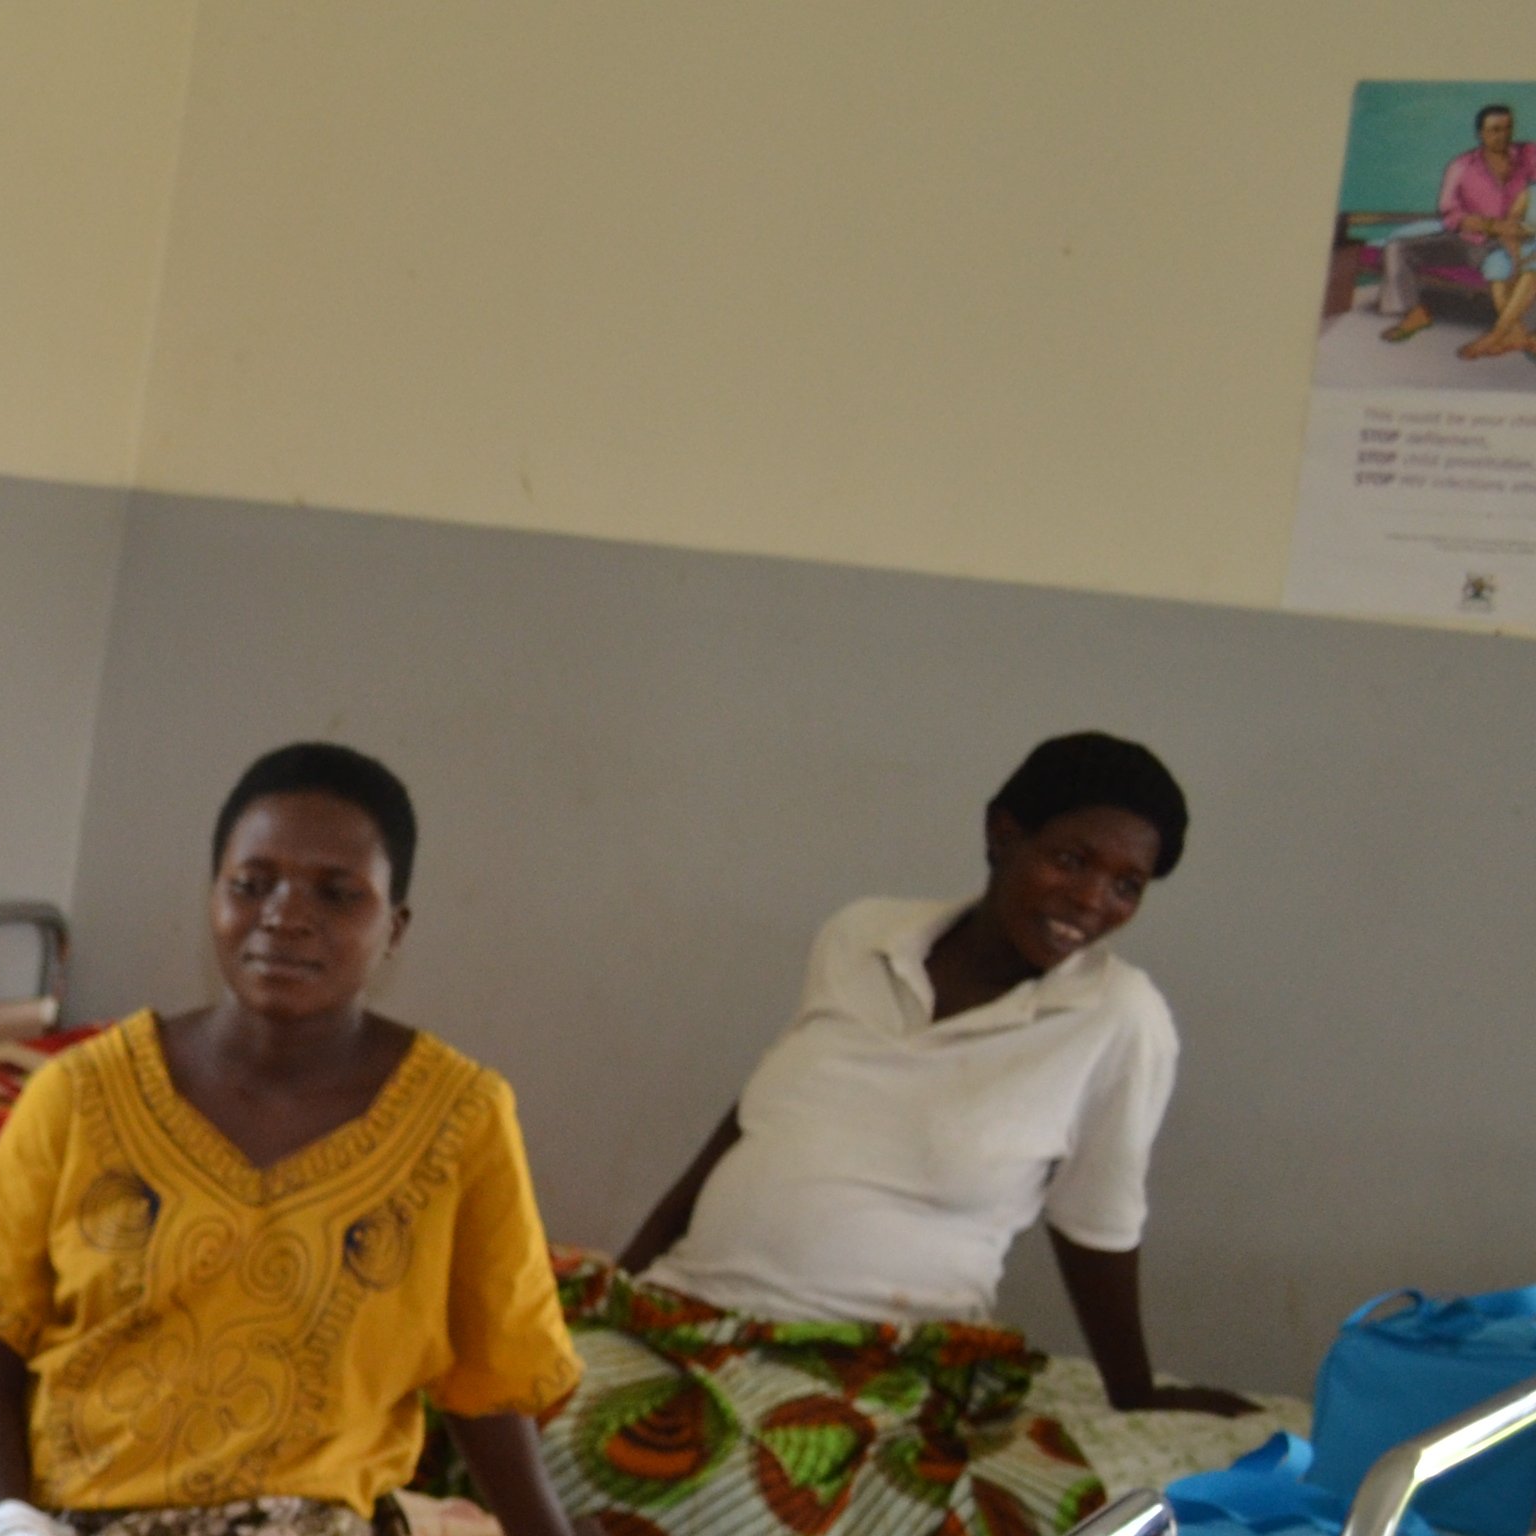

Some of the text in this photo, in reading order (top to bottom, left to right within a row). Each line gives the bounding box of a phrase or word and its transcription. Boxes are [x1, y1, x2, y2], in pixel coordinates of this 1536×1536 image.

[1360, 429, 1400, 443] STOP
[1358, 450, 1397, 464] STOP
[1355, 471, 1395, 485] STOP
